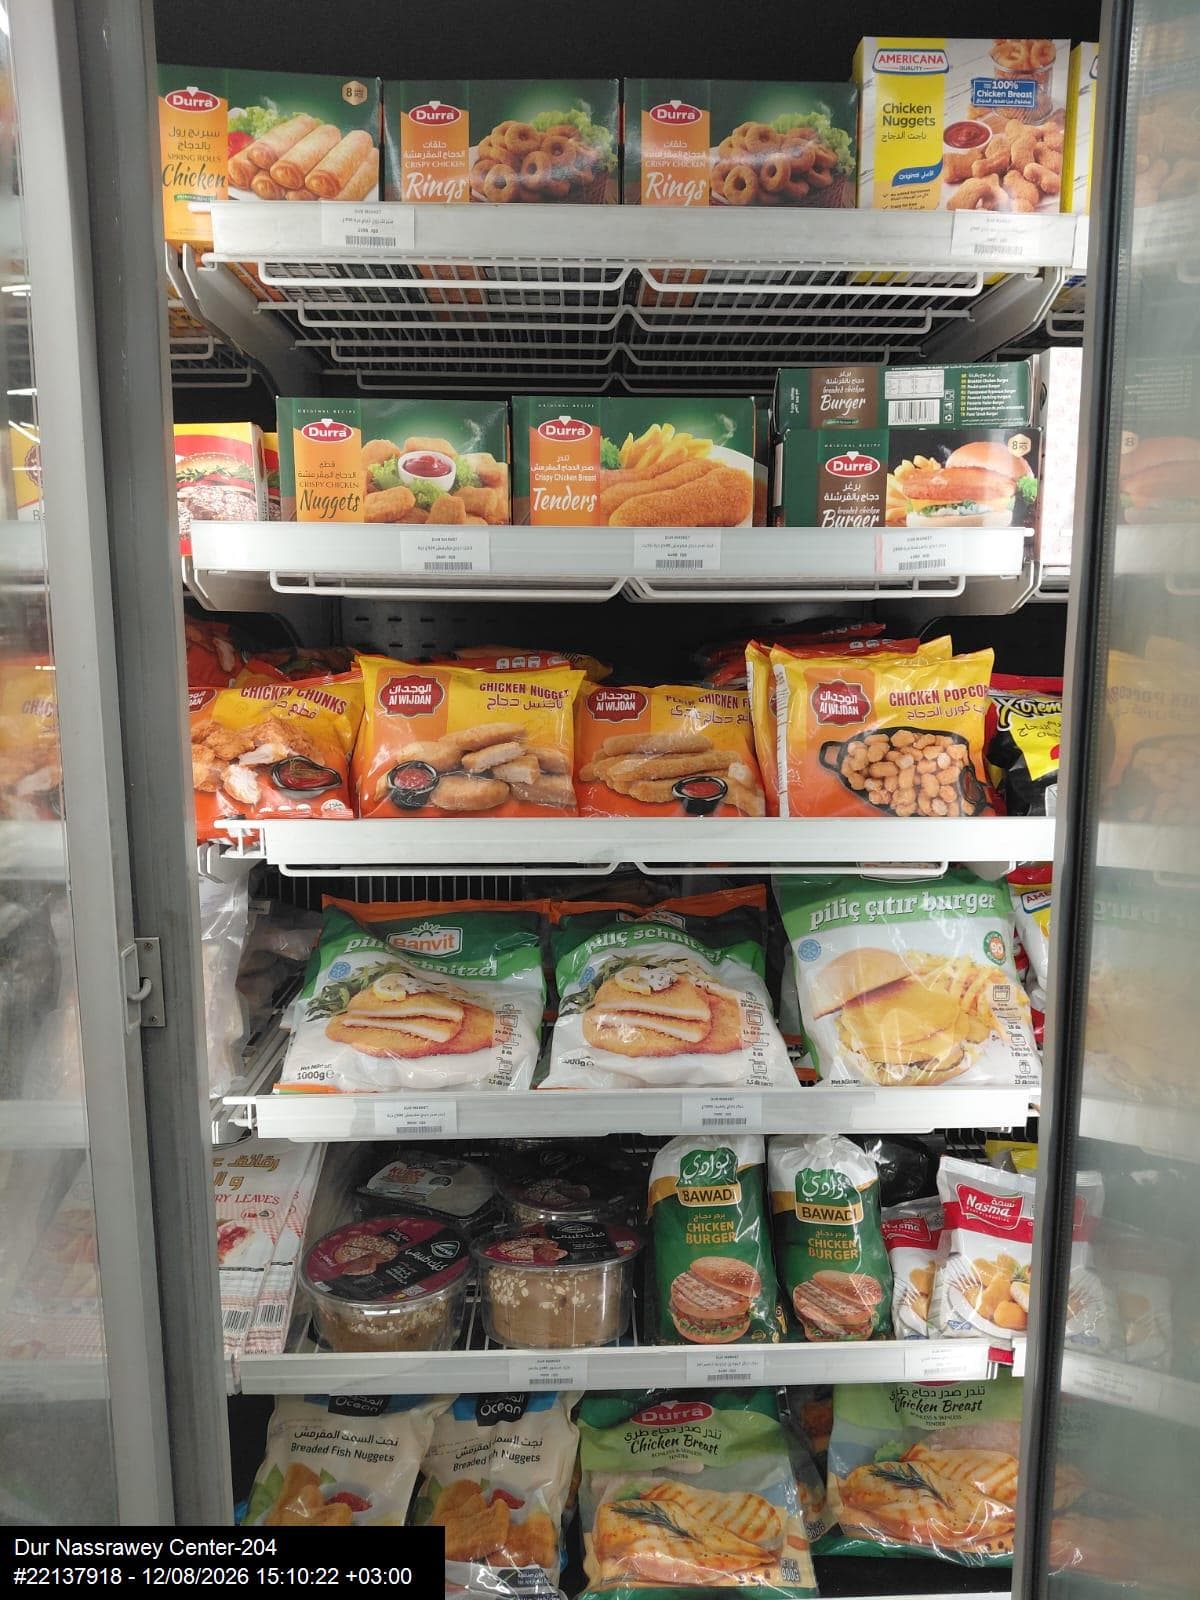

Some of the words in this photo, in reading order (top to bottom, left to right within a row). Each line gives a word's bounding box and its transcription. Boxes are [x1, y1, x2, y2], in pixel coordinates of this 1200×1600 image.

[879, 54, 944, 64] AMERICANA
[992, 81, 1019, 90] 100%
[346, 88, 353, 97] 8
[977, 90, 1007, 98] Chicken
[173, 95, 214, 108] Durra
[657, 109, 696, 120] Durra
[883, 102, 932, 115] Chicken
[416, 110, 455, 121] Durra
[882, 115, 936, 129] Nuggets
[405, 160, 430, 169] CRISPY
[432, 160, 465, 169] CHICKEN
[162, 162, 226, 190] Chicken
[406, 172, 468, 204] Rings
[646, 171, 707, 207] Rings
[820, 394, 866, 416] Burger
[308, 427, 347, 438] Durra
[545, 425, 586, 436] Durra
[1012, 441, 1018, 450] 8
[833, 461, 873, 472] Durra
[300, 489, 361, 519] Nuggets
[532, 485, 597, 513] Tenders
[389, 684, 432, 695] الوجدان
[480, 682, 526, 694] CHICKEN
[297, 689, 347, 716] CHUNKS
[399, 694, 432, 705] WIJDAN
[699, 694, 739, 709] CHICKEN
[889, 689, 940, 707] CHICKEN
[606, 701, 636, 711] WIJDAN
[828, 703, 859, 716] WIJDAN
[809, 898, 862, 932] piliç
[865, 896, 918, 922] çıtır
[921, 892, 996, 915] burger
[235, 1194, 280, 1205] LEAVES
[683, 1188, 735, 1203] BAWADI
[966, 1193, 1010, 1218] Nasma
[802, 1206, 857, 1222] BAWADI
[687, 1221, 734, 1233] CHICKEN
[686, 1232, 737, 1245] BURGER
[808, 1238, 857, 1249] CHICKEN
[808, 1247, 859, 1261] BURGER
[912, 1388, 937, 1399] دجاج
[938, 1389, 962, 1399] صدر
[335, 1396, 379, 1413] Ocean
[480, 1402, 521, 1416] Ocean
[942, 1400, 983, 1413] Breast
[641, 1408, 704, 1422] Durra
[651, 1427, 677, 1437] دجاج
[678, 1426, 701, 1434] صدر
[631, 1435, 680, 1455] Chicken
[683, 1434, 719, 1455] Breast
[290, 1442, 331, 1454] Breaded
[330, 1446, 351, 1458] Fish
[354, 1450, 395, 1464] Nuggets
[452, 1456, 487, 1472] Breaded
[501, 1449, 541, 1464] Nuggets
